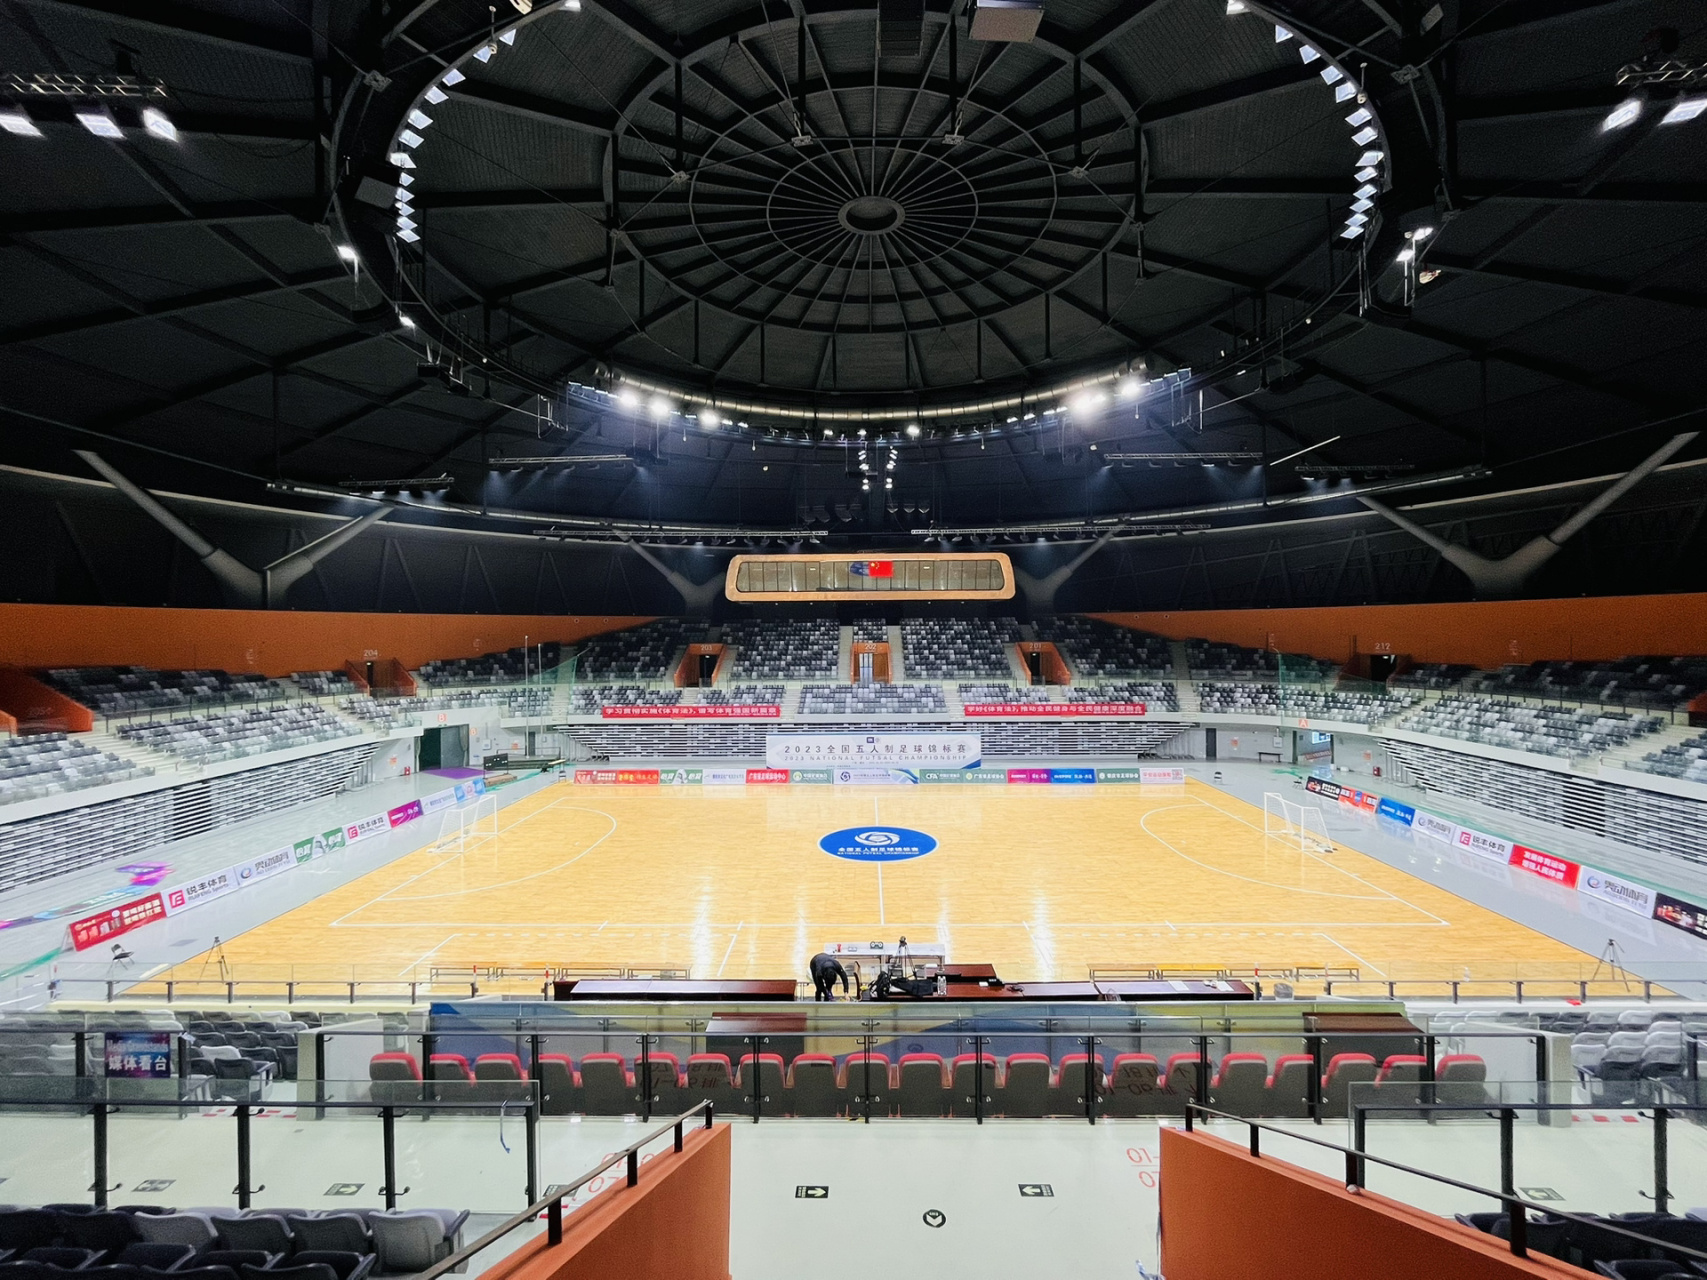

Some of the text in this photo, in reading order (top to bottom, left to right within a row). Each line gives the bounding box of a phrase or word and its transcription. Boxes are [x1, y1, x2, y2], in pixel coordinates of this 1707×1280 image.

[1375, 642, 1391, 650] 212
[784, 744, 967, 754] 2023全国五人制足球锦标赛
[186, 874, 228, 896] 锐丰体育
[108, 1054, 167, 1071] 媒体看台
